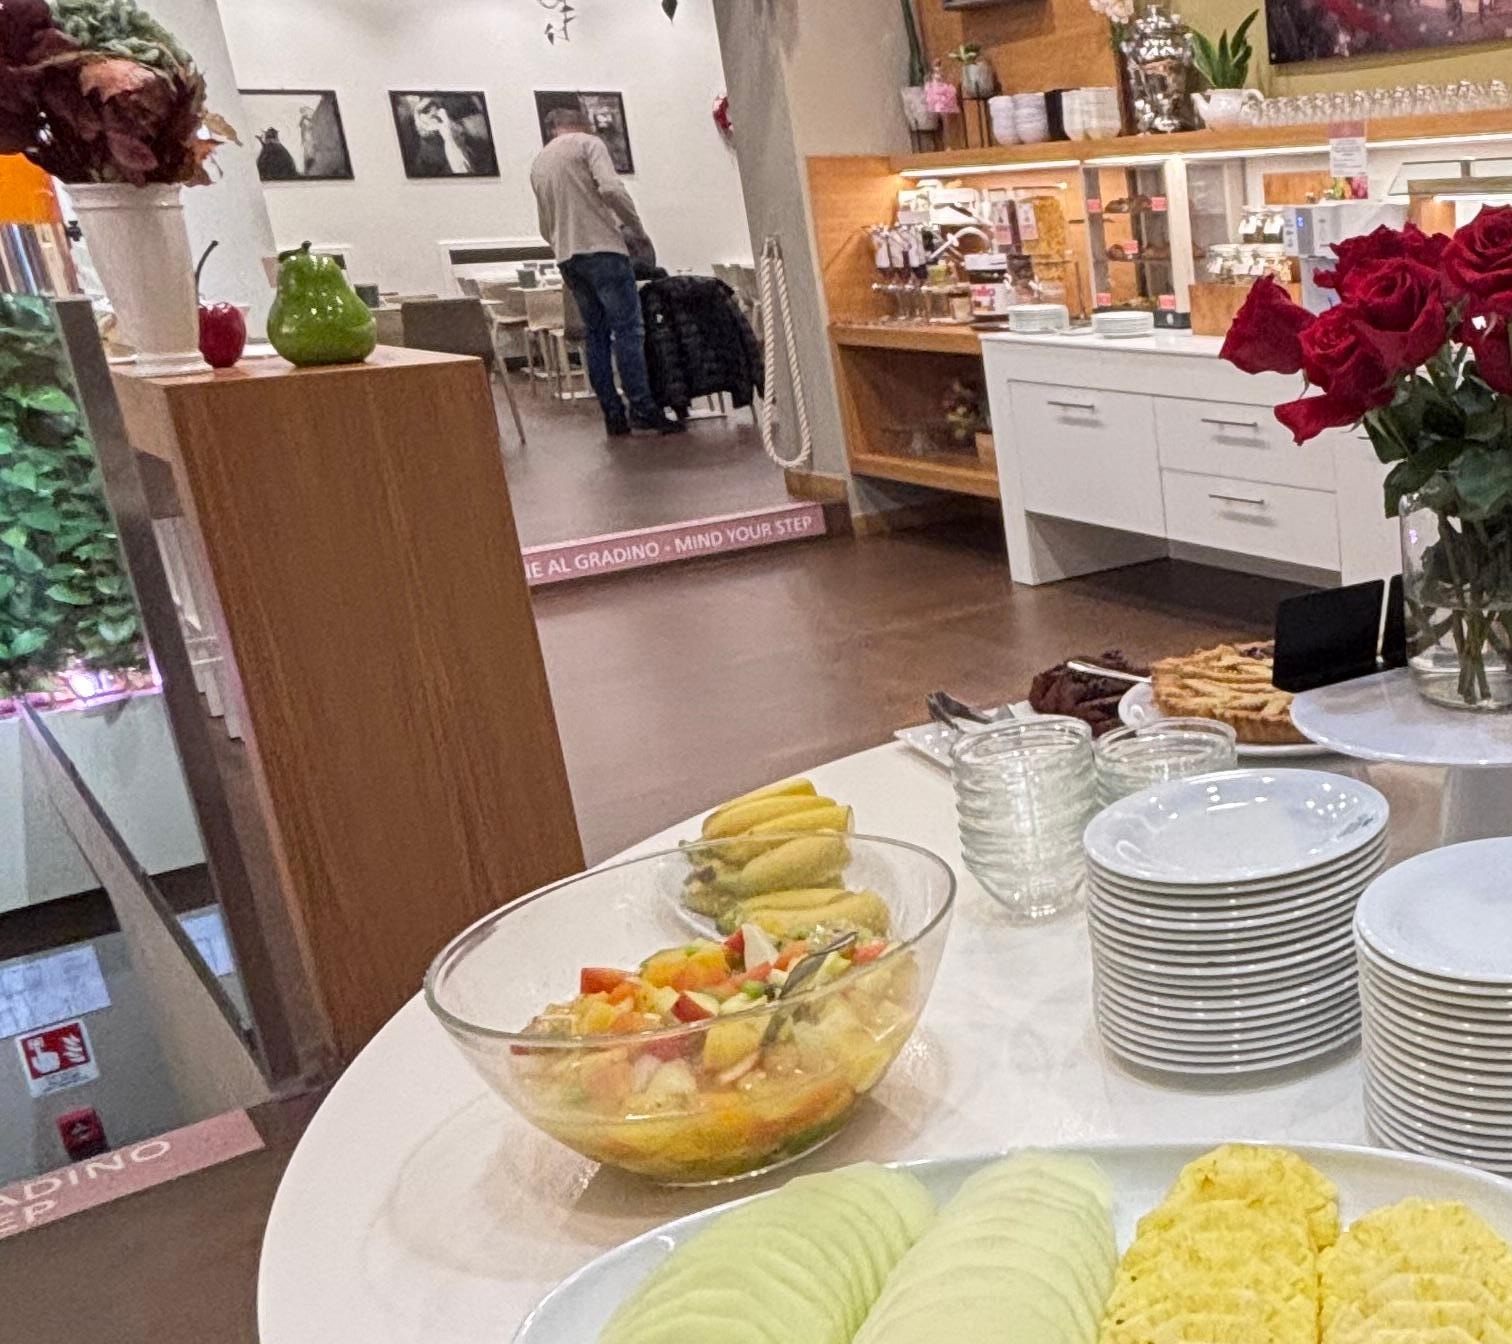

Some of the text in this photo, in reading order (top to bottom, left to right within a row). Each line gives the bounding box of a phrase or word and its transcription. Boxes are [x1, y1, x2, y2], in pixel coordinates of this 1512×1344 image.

[548, 556, 572, 576] AL
[574, 541, 660, 570] GRADINO
[674, 531, 723, 554] MIND
[726, 522, 773, 543] YOUR
[774, 515, 812, 536] STEP
